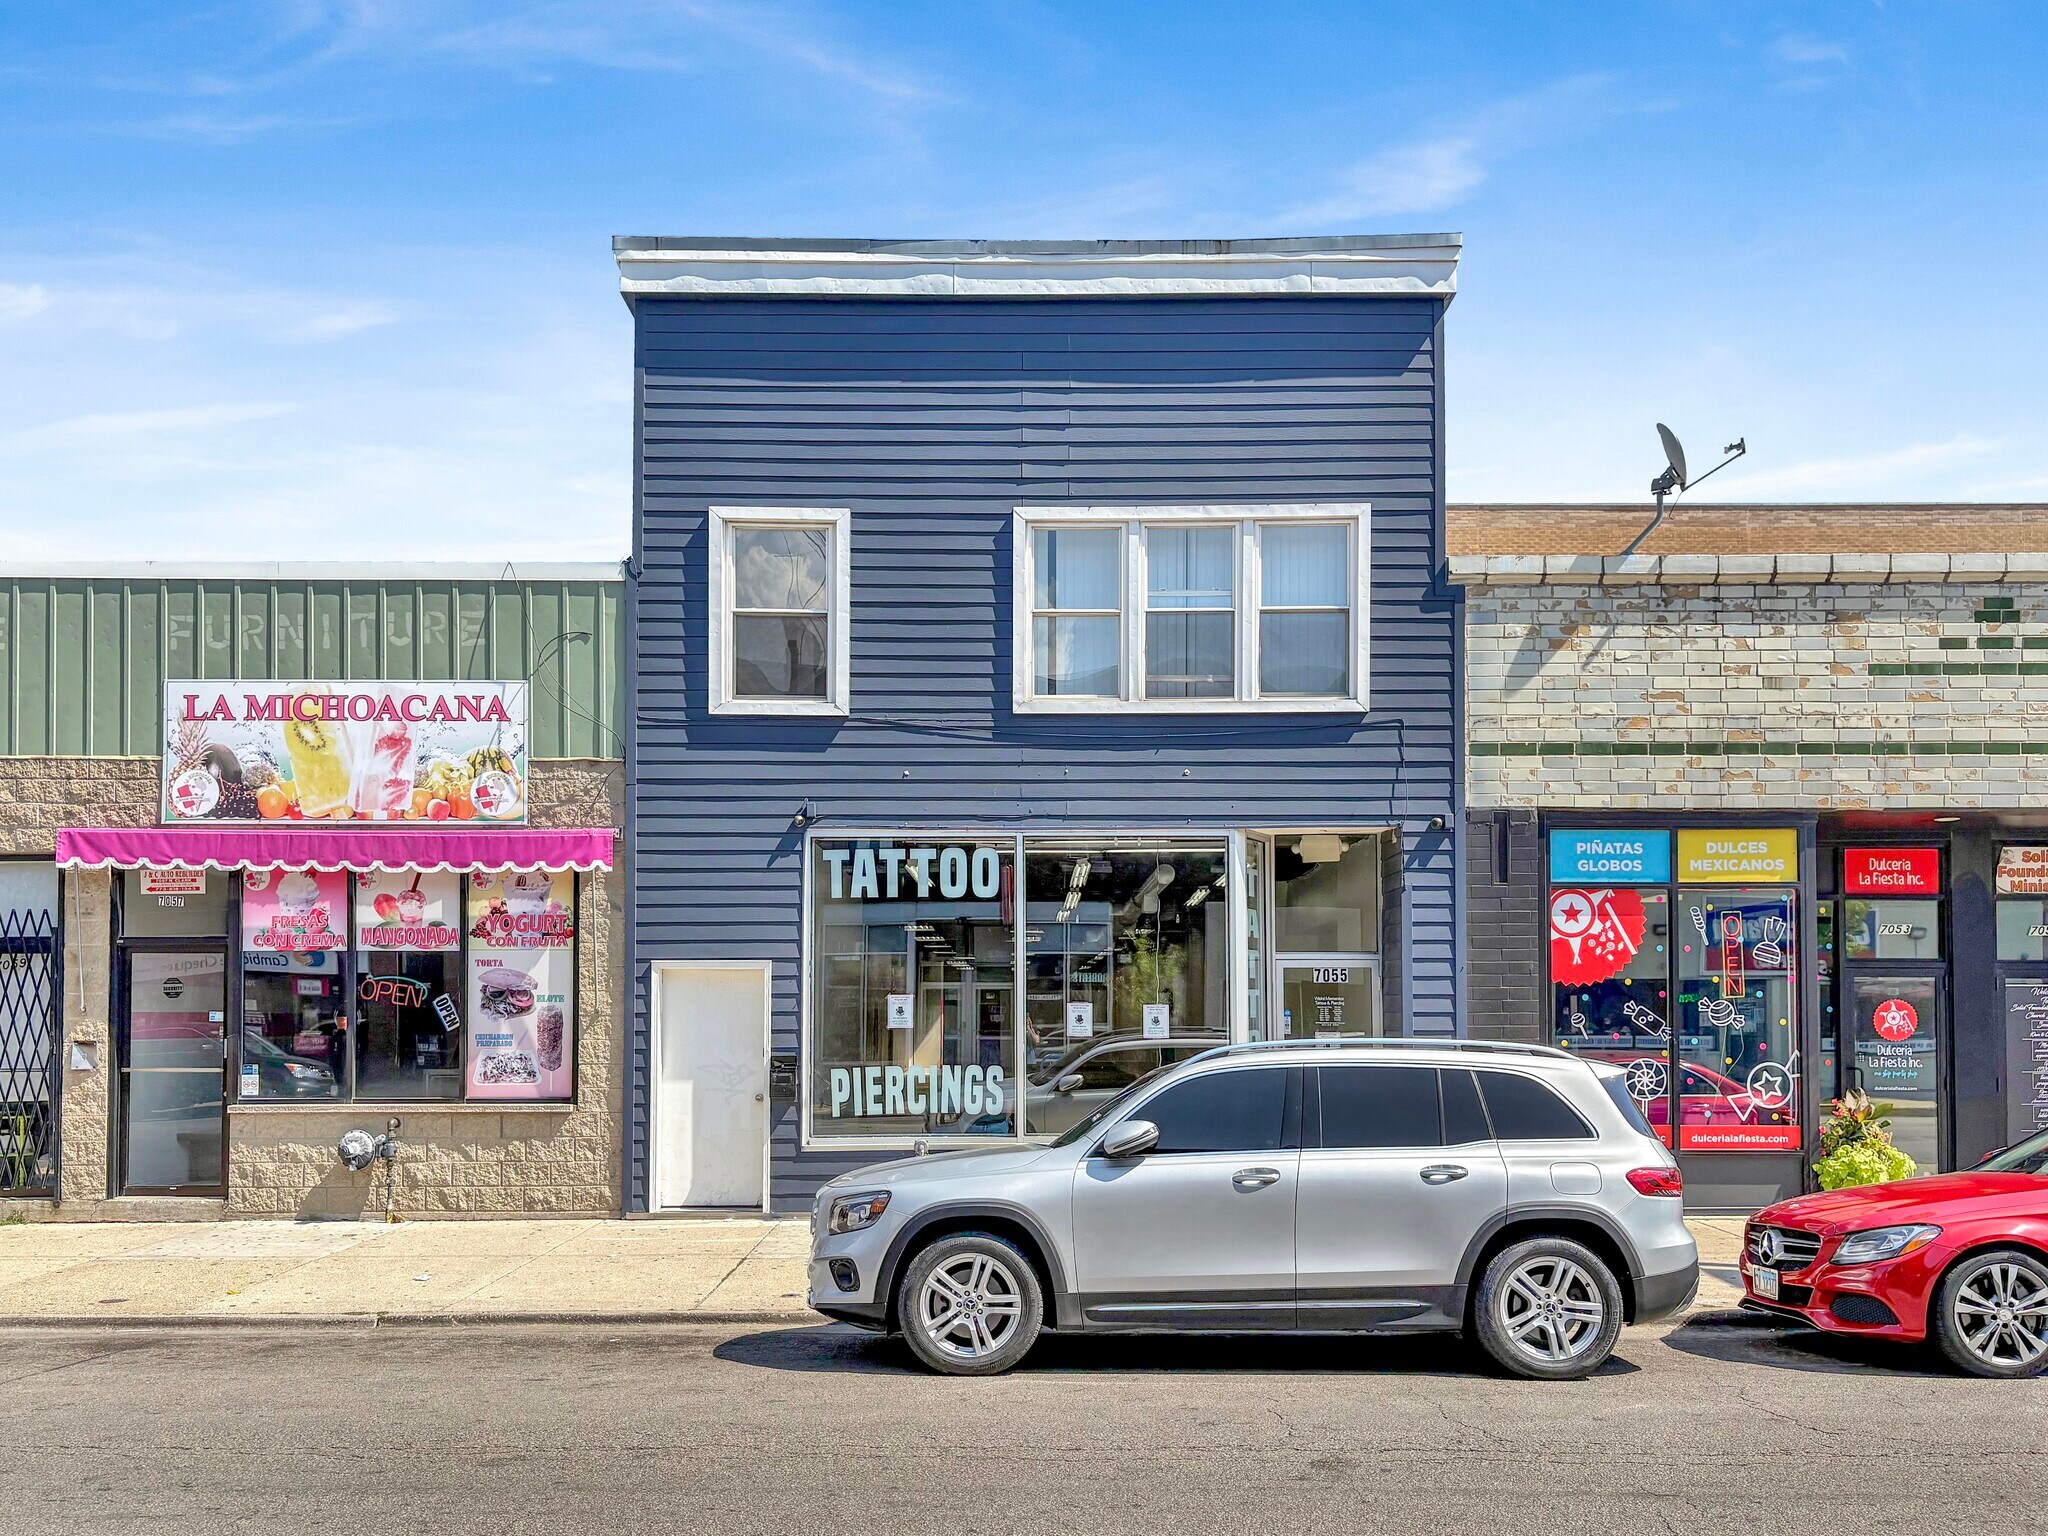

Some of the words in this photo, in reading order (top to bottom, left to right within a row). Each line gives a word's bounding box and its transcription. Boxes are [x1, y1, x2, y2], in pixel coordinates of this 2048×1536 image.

[170, 611, 486, 651] FURNITURE
[182, 695, 236, 722] LA
[243, 694, 511, 722] MICHOACANA
[1576, 840, 1643, 855] PIÑATAS
[1706, 842, 1768, 854] DULCES
[1577, 859, 1643, 872] GLOBOS
[1689, 859, 1785, 872] MEXICANOS
[1869, 857, 1911, 871] Dulceria
[822, 848, 1000, 899] TATTOO
[1859, 873, 1871, 885] La
[1873, 872, 1905, 885] Fiesta
[1907, 872, 1924, 885] Inc.
[1997, 865, 2048, 878] Found
[158, 896, 185, 906] 7057
[271, 915, 328, 929] FRESAS
[487, 914, 568, 934] YOGURT
[361, 927, 460, 946] MANGONADA
[1880, 925, 1911, 934] 7053
[253, 933, 287, 947] CON
[290, 933, 346, 948] CREMA
[486, 936, 518, 947] CON
[520, 936, 569, 947] FRUTA
[1723, 915, 1742, 996] OPEN
[475, 959, 503, 967] TORTA
[1314, 968, 1347, 982] 7055
[360, 979, 424, 1008] OPEN
[536, 995, 565, 1003] ELOTE
[436, 997, 459, 1028] OPEN
[1877, 1044, 1912, 1056] Dulceria
[1869, 1057, 1879, 1067] La
[1880, 1057, 1907, 1068] Fiesta
[1909, 1057, 1923, 1068] Inc.
[830, 1065, 1005, 1118] PIERCINGS
[1691, 1134, 1789, 1143] dulcerialafiesta.com
